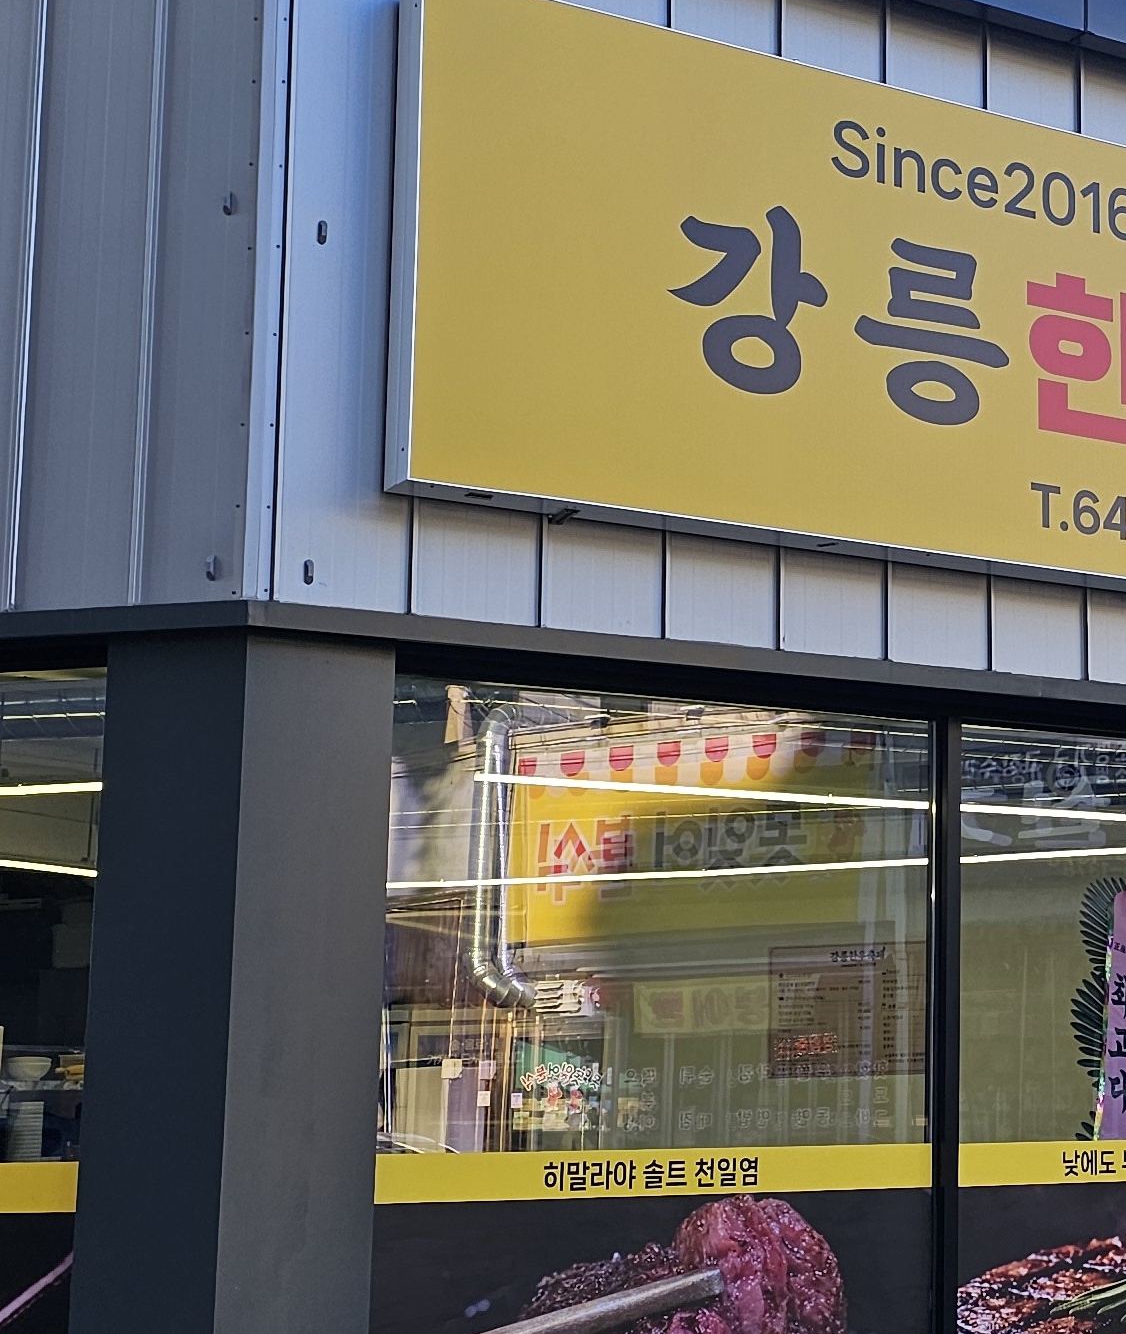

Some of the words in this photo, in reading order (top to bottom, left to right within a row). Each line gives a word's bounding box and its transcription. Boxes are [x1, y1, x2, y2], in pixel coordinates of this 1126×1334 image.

[543, 1158, 636, 1192] 히말라야
[643, 1159, 686, 1189] 솔트
[694, 1156, 760, 1187] 천일염
[1062, 1150, 1117, 1176] 낮에도
